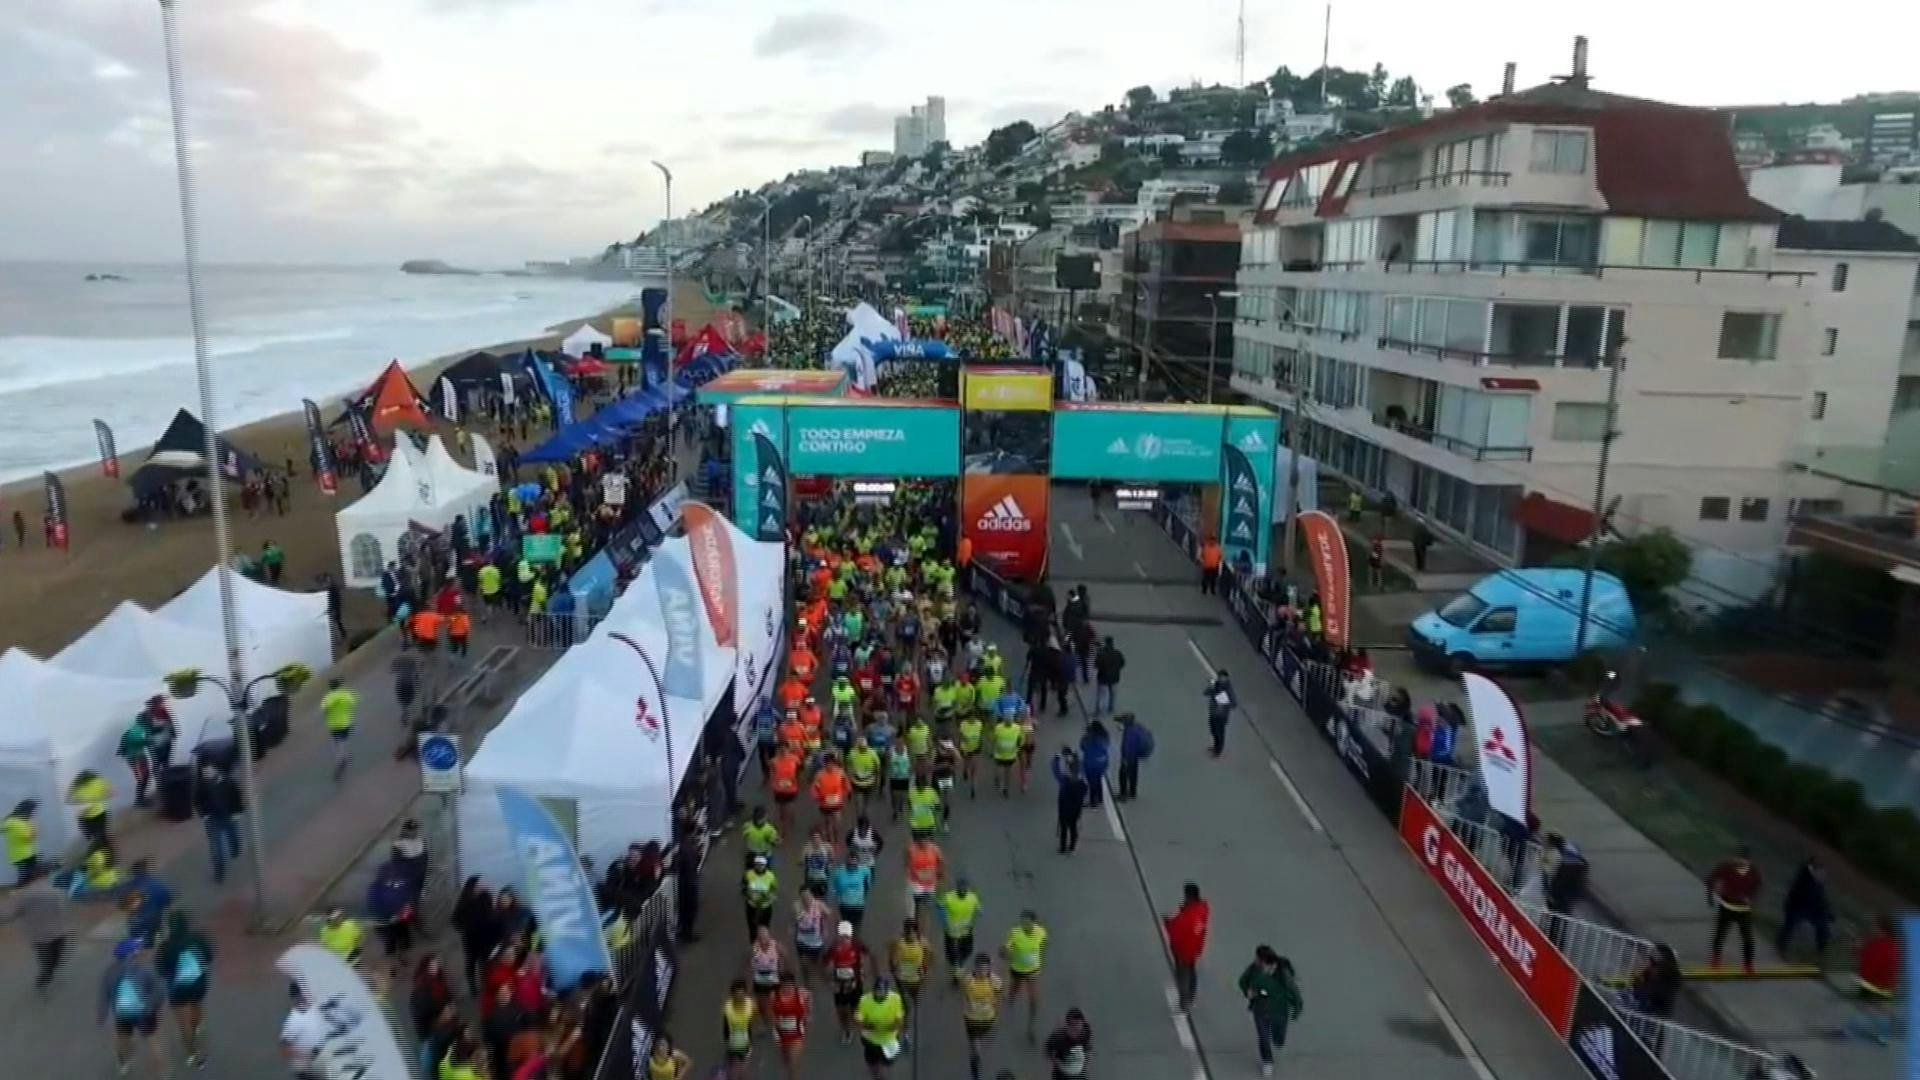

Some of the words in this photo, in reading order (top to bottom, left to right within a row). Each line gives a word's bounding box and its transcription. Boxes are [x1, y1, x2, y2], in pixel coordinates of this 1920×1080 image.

[799, 428, 840, 441] TODO
[843, 428, 906, 441] EMPIEZA
[798, 441, 867, 454] CONTIGO
[977, 517, 1031, 532] adidas
[1422, 824, 1441, 867] G
[1442, 850, 1538, 980] GATORADE
